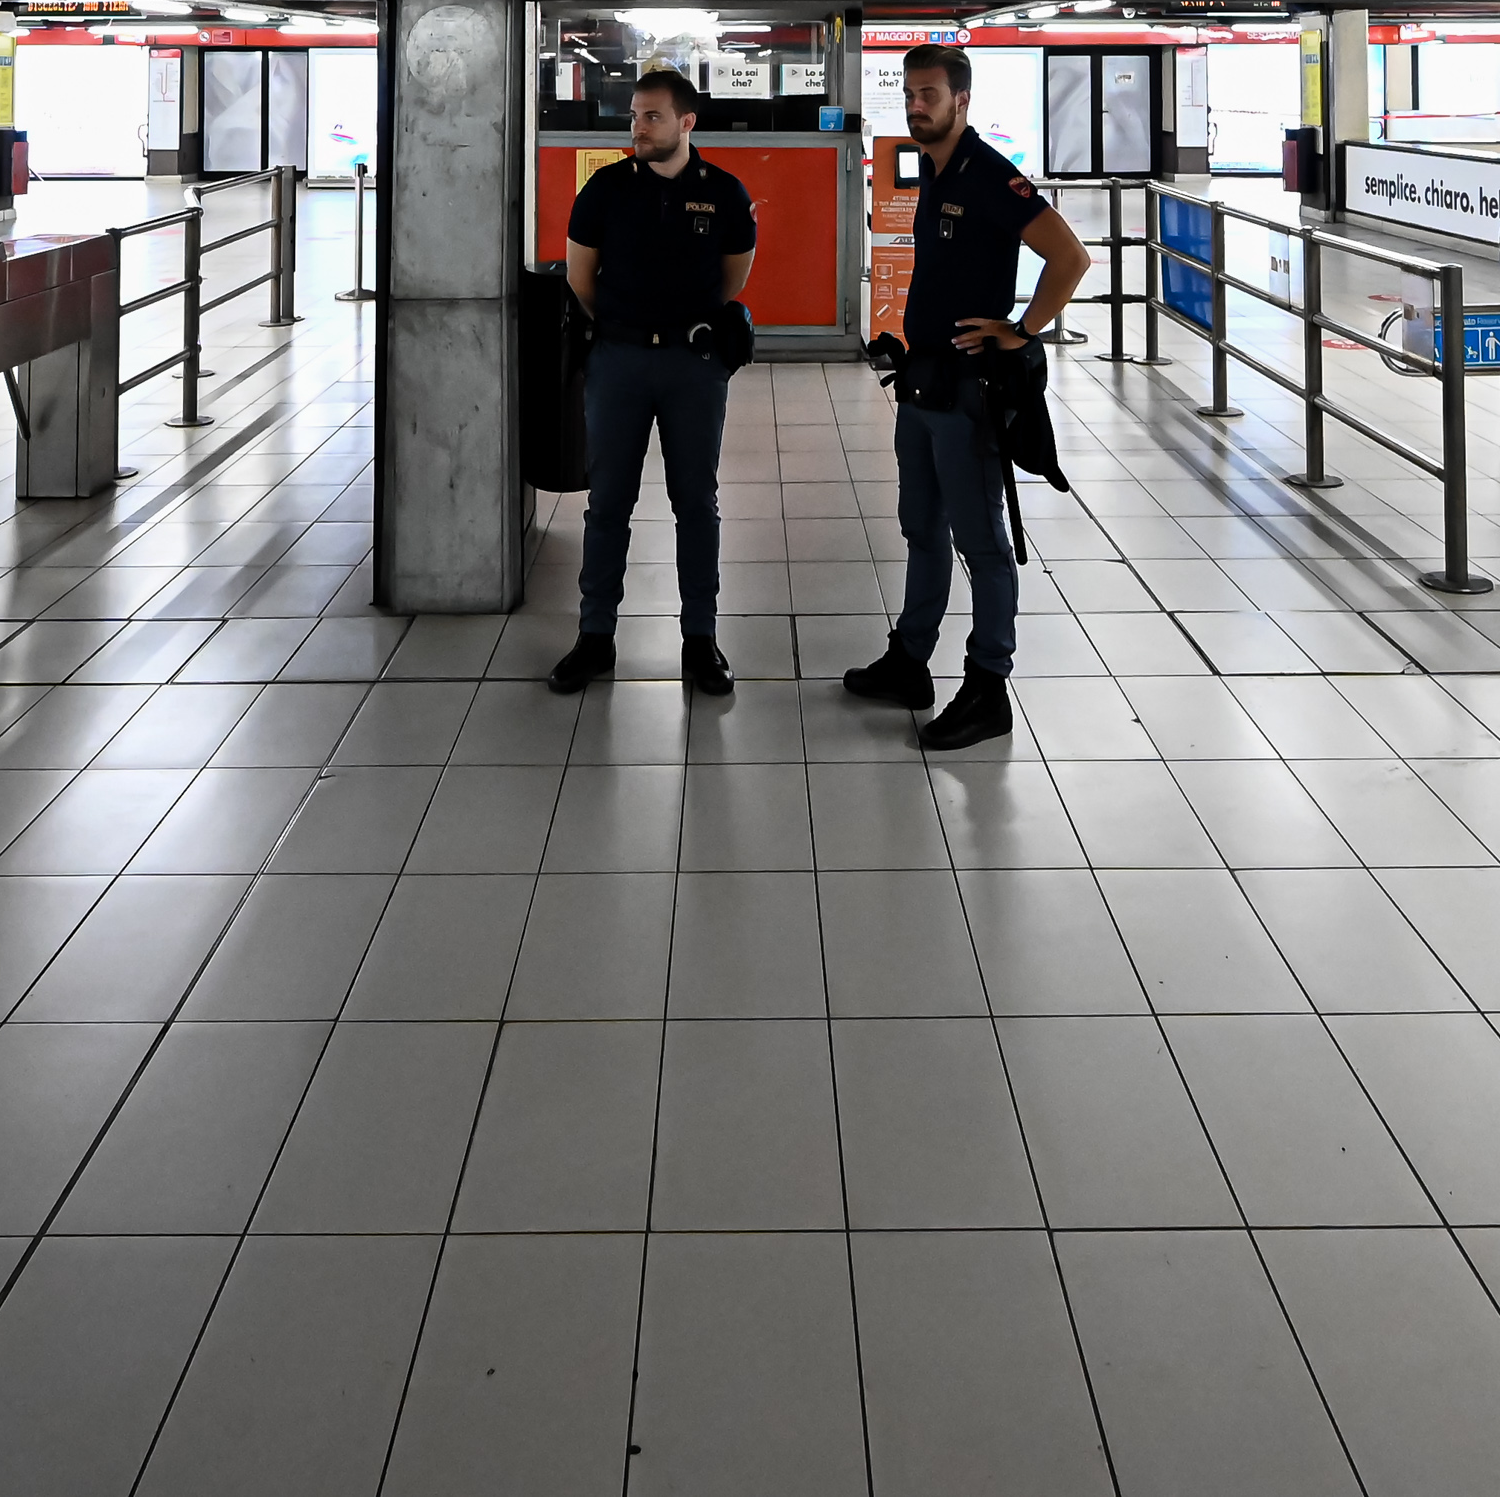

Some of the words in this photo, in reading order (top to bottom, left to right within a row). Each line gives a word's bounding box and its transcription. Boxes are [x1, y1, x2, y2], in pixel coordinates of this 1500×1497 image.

[876, 32, 913, 41] MAGGIO
[914, 32, 926, 41] FS
[732, 69, 743, 77] Lo
[745, 69, 759, 77] sai
[805, 69, 816, 77] Lo
[879, 69, 890, 77] Lo
[731, 78, 752, 87] che?
[878, 79, 899, 87] che?
[1364, 173, 1421, 206] semplice.
[1424, 178, 1474, 215] chiaro.
[687, 203, 714, 212] POLIZIA
